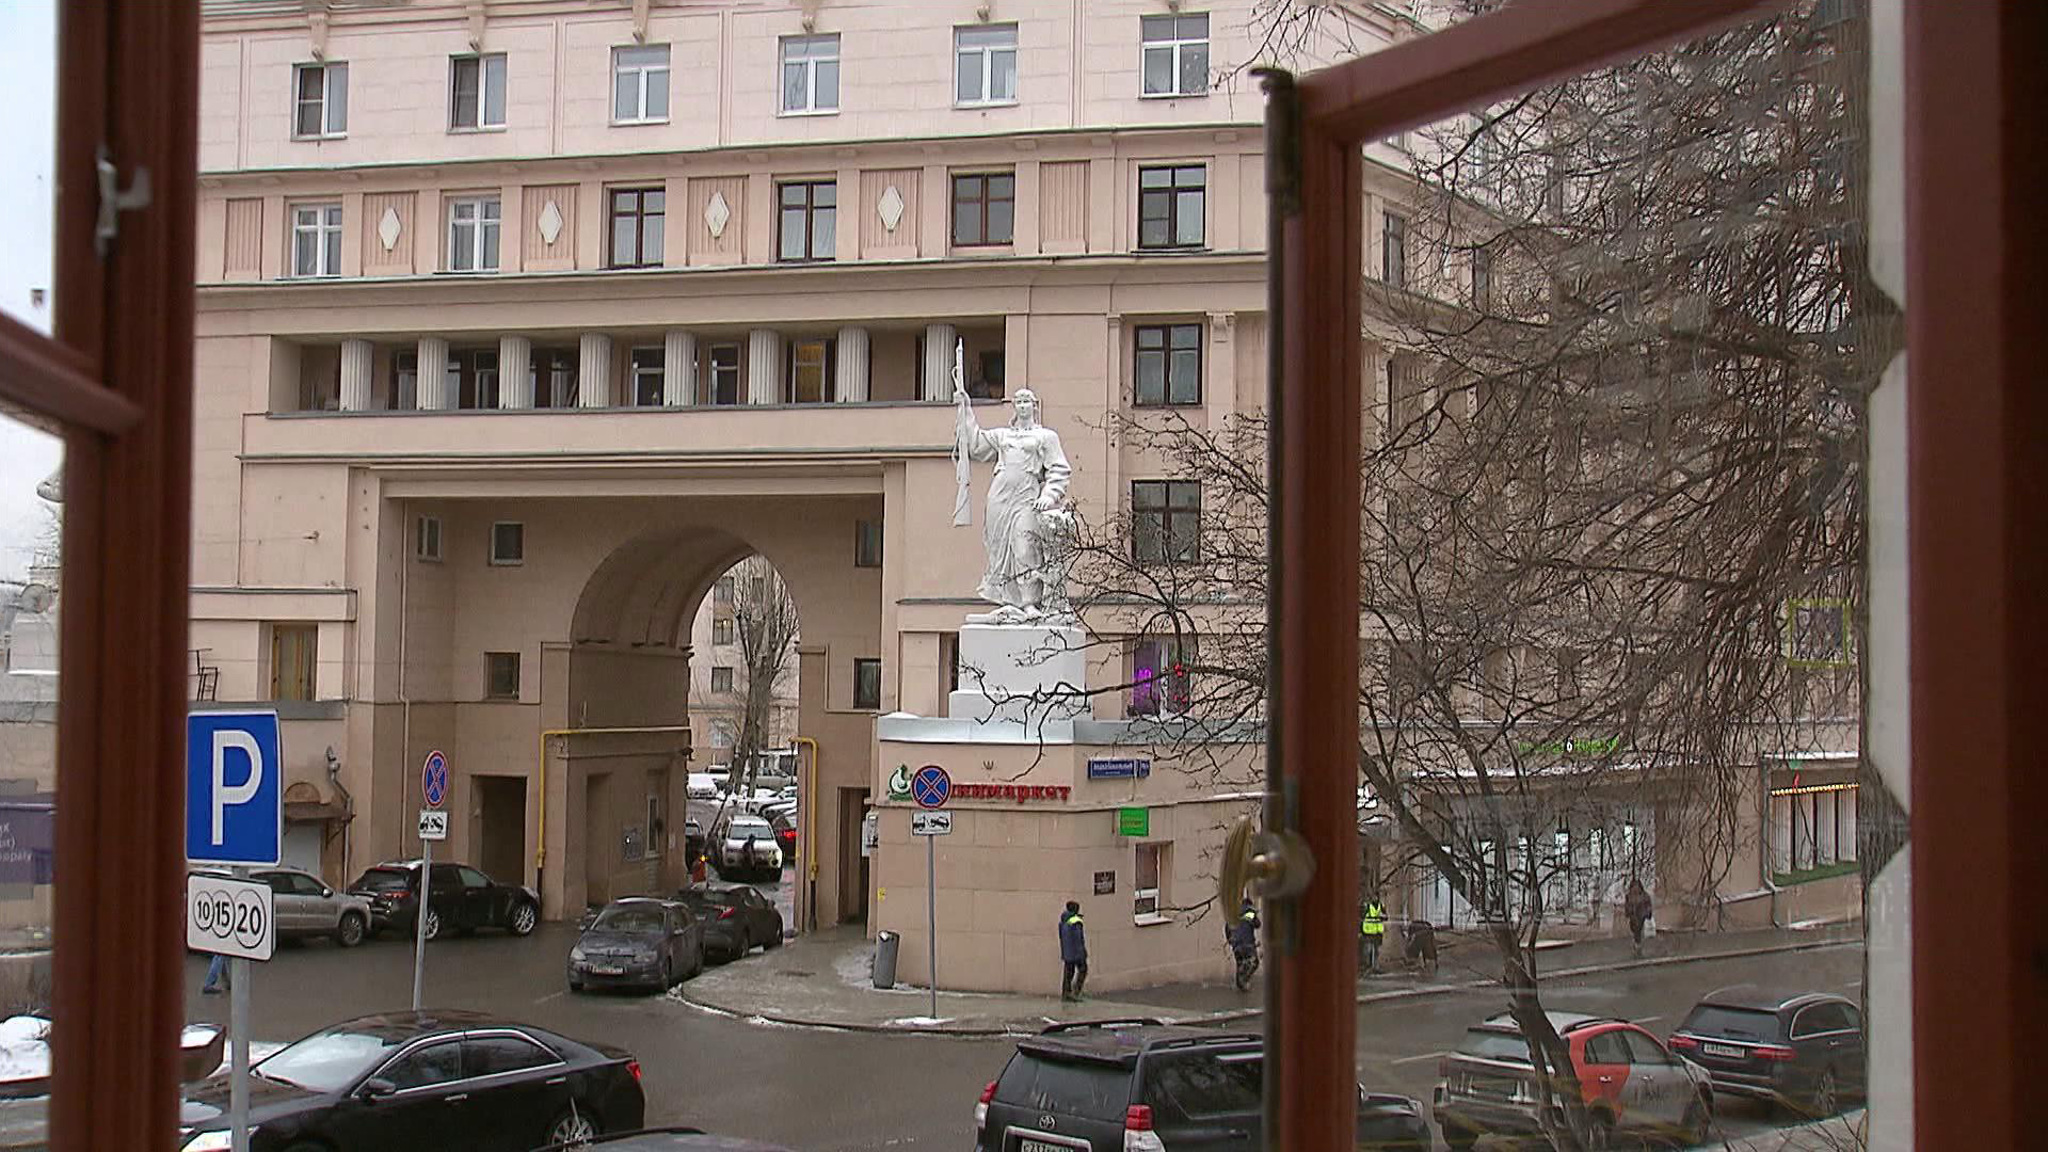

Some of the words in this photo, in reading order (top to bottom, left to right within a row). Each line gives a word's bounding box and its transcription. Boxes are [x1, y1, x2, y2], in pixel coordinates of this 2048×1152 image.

[211, 729, 263, 846] P
[197, 900, 211, 921] 10
[215, 900, 231, 928] 15
[236, 903, 263, 936] 20
